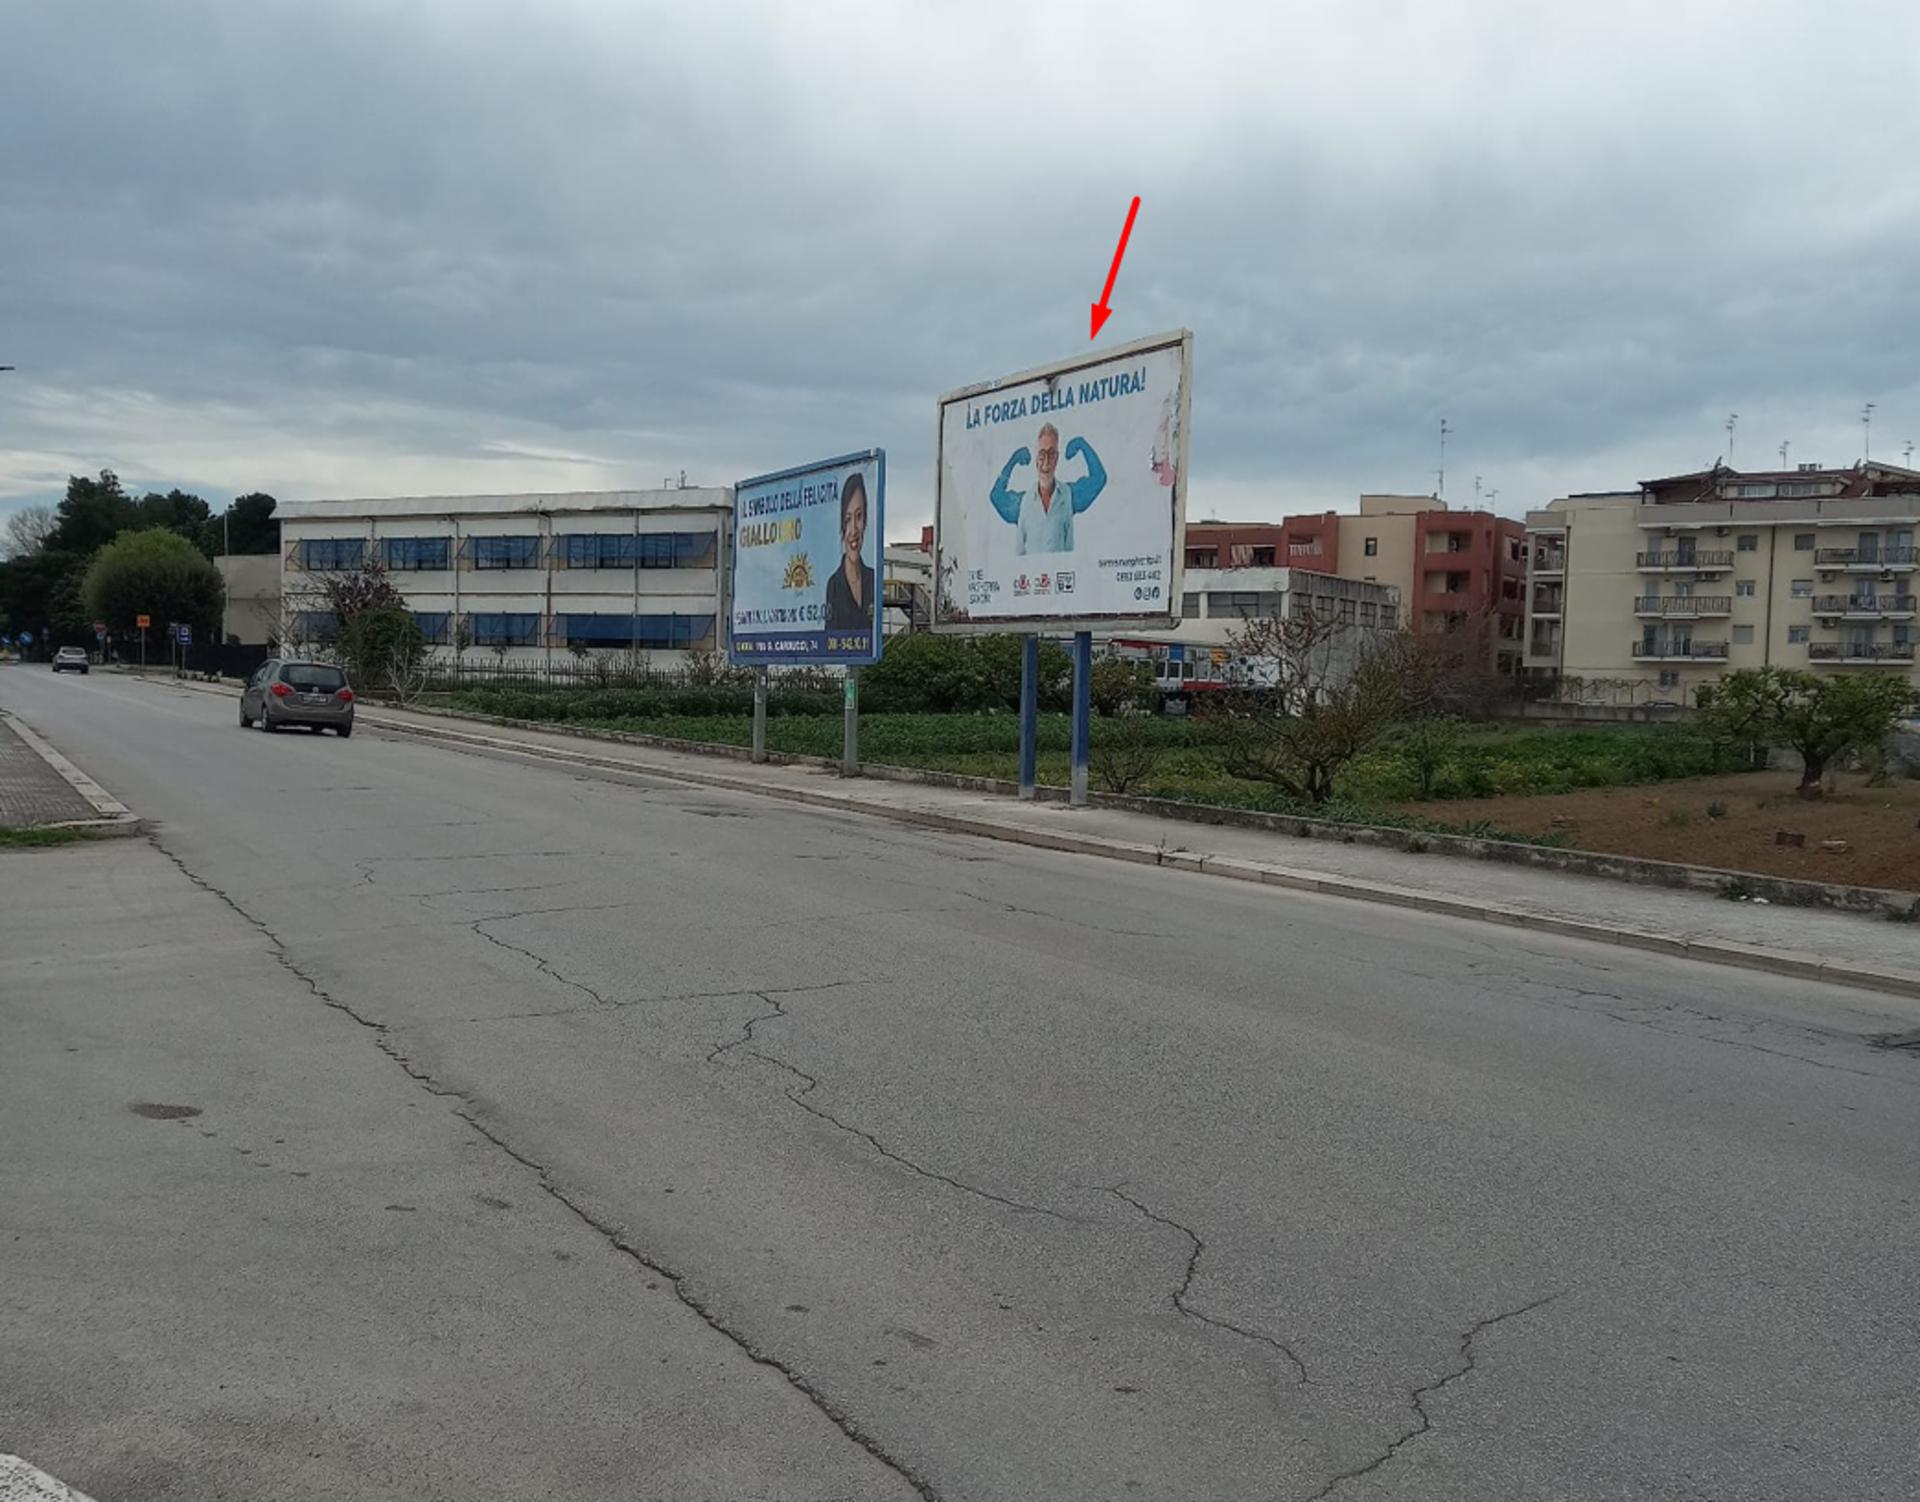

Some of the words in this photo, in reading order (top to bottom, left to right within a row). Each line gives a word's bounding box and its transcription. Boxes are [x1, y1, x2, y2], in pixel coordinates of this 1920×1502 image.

[966, 402, 981, 429] LA
[984, 397, 1027, 425] FORZA
[1031, 386, 1074, 414] DELLA
[1079, 366, 1146, 404] NATURA!
